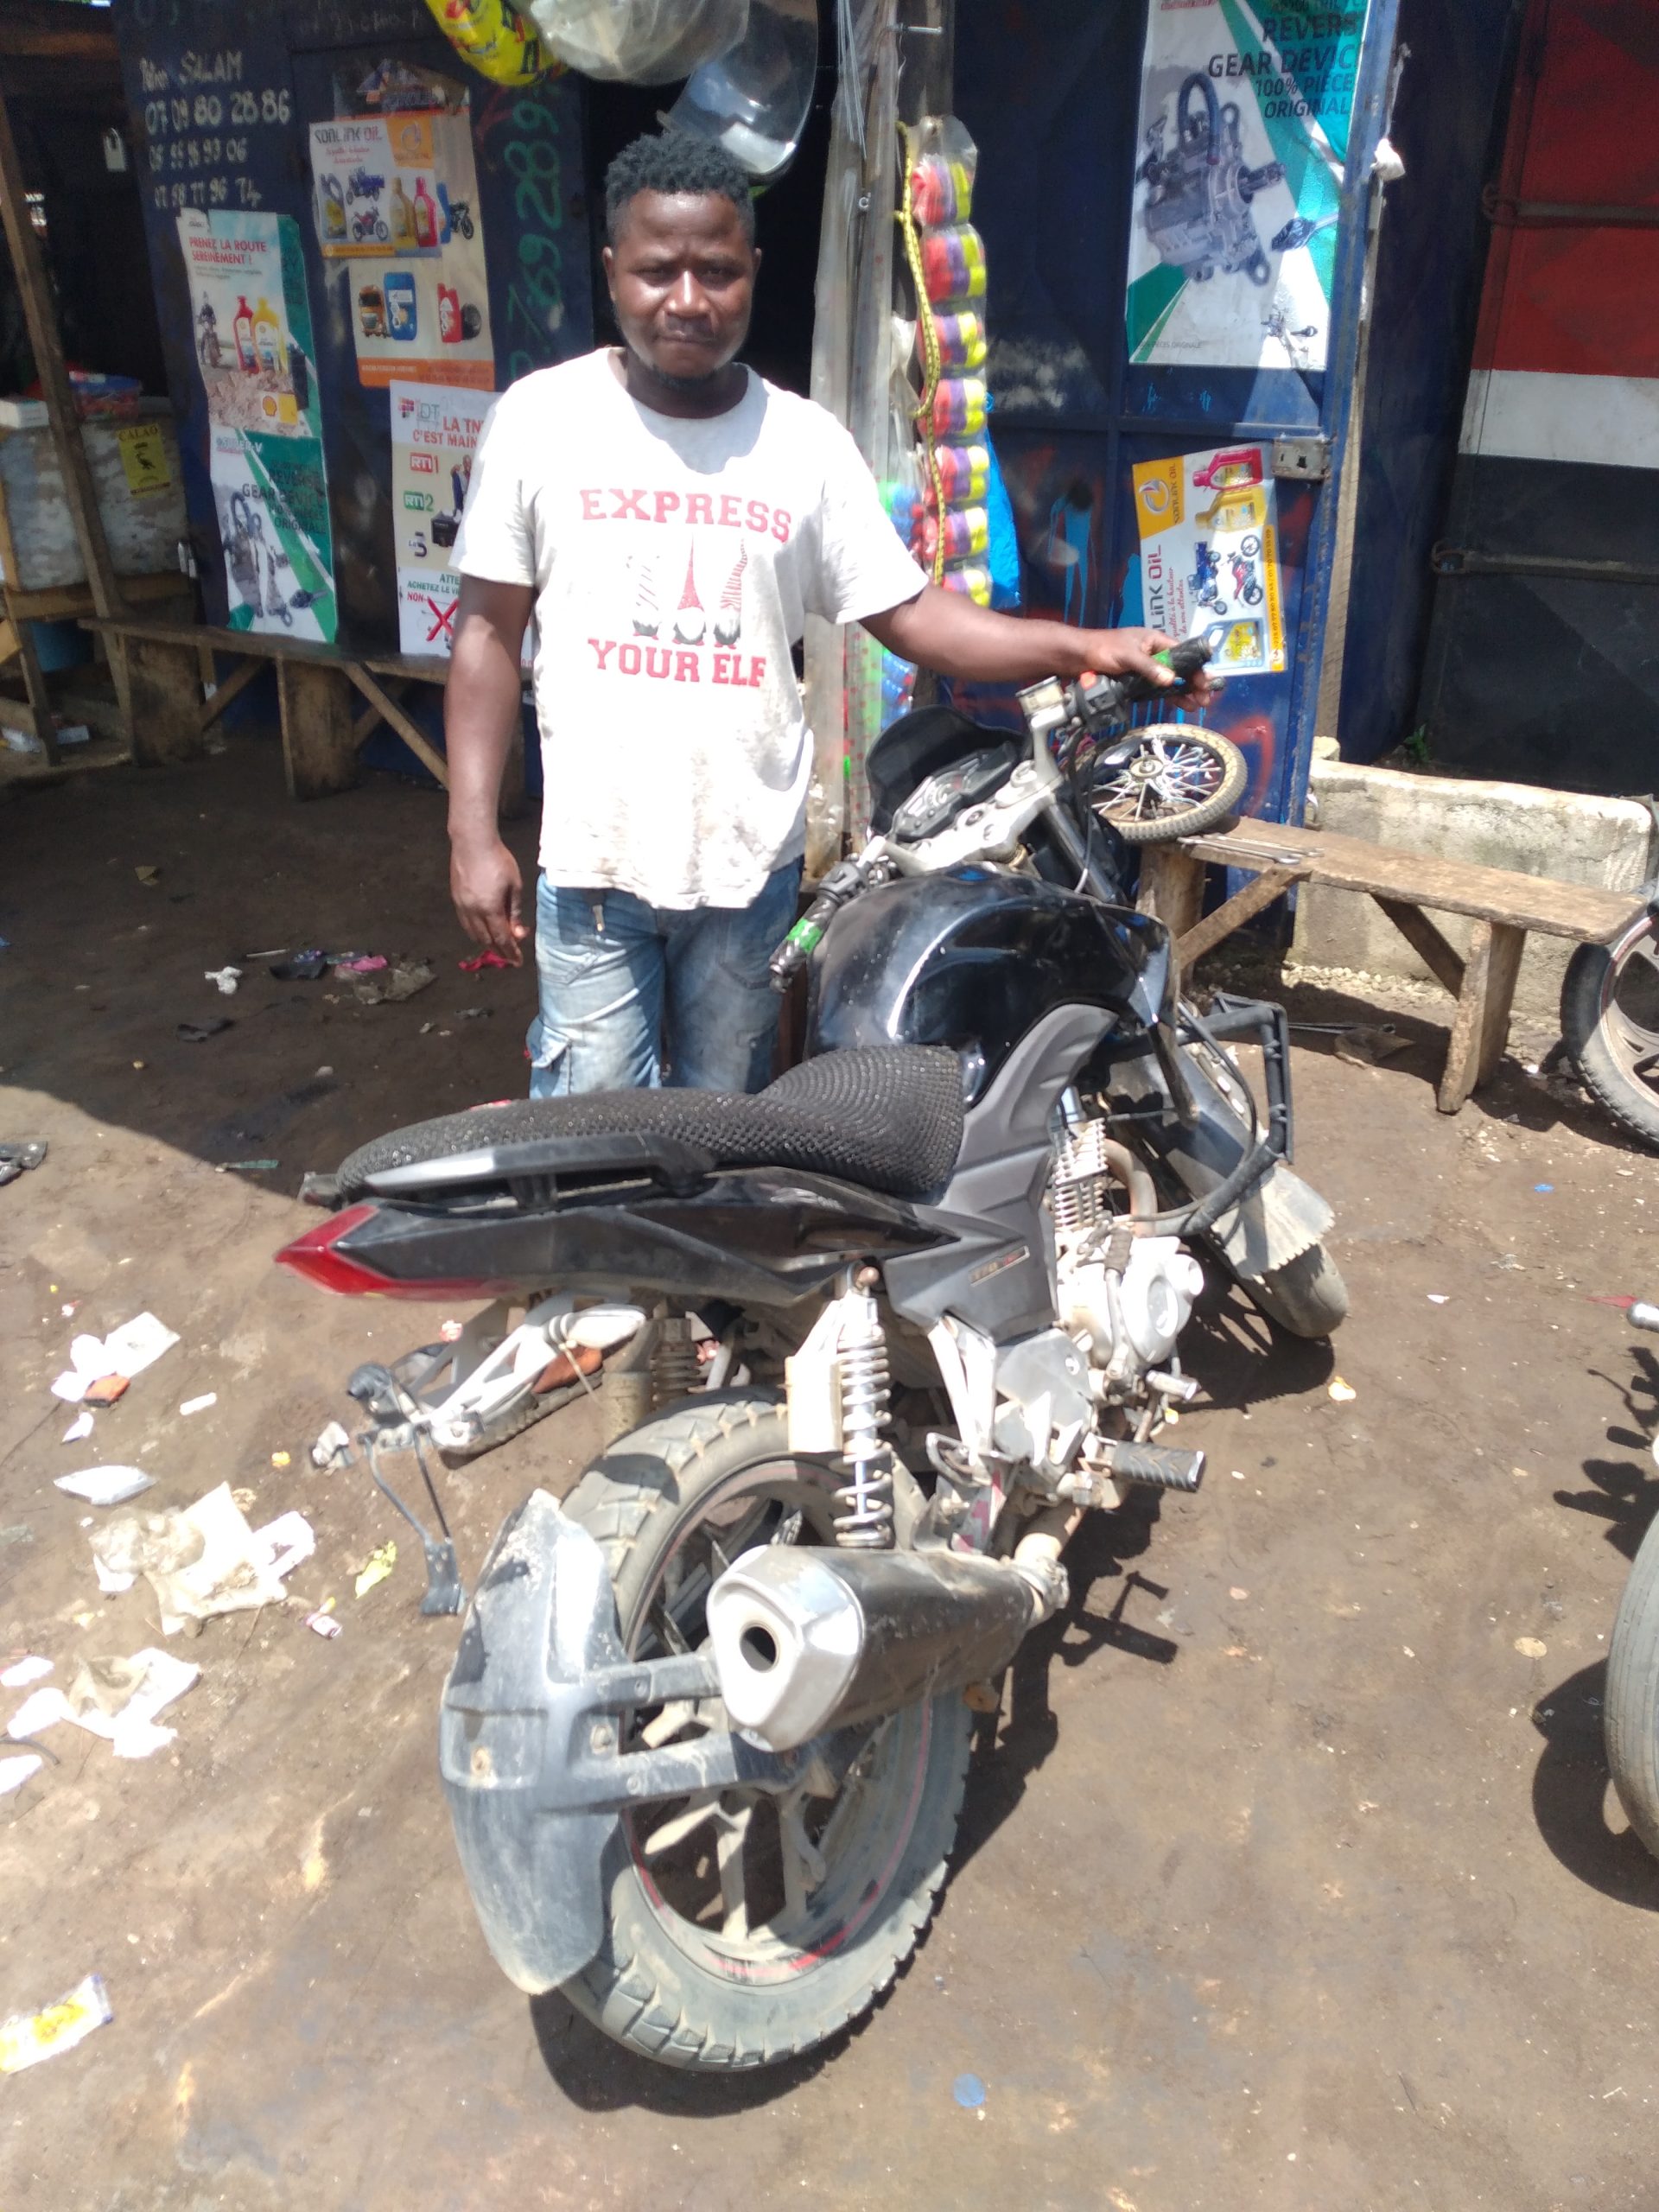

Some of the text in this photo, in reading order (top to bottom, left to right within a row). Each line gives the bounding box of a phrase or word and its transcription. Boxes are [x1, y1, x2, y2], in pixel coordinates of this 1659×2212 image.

[1209, 52, 1272, 78] GEAR
[1255, 77, 1299, 97] 100%
[194, 94, 222, 126] 80
[231, 90, 258, 124] 28
[262, 88, 290, 124] 86
[226, 137, 248, 162] 06
[219, 239, 232, 251] LA
[234, 240, 267, 252] ROUTE
[442, 416, 486, 434] LA TN
[413, 429, 443, 445] C'EST
[411, 455, 432, 471] RTI
[404, 493, 424, 507] RTI
[579, 487, 791, 543] EXPRESS
[407, 580, 440, 592] ACHETEZ
[442, 585, 450, 594] LE
[407, 591, 424, 603] NON
[588, 638, 767, 688] YOUR ELF
